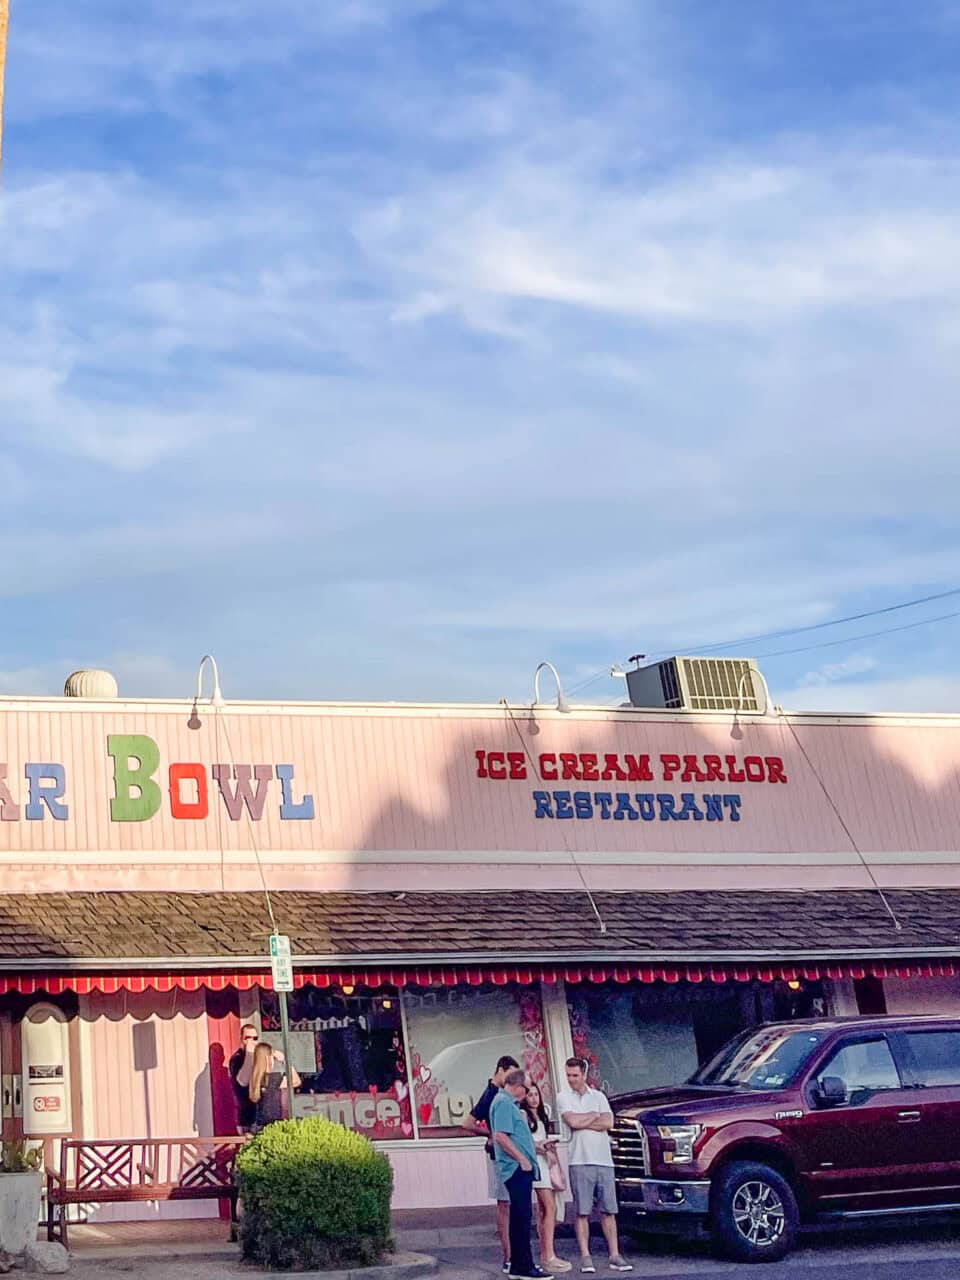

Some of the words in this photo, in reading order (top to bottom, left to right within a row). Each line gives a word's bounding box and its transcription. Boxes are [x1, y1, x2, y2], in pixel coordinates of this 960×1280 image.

[107, 734, 315, 822] BOWL
[476, 750, 527, 780] ICE
[539, 753, 654, 782] CREAM
[660, 754, 788, 784] PARLOR
[533, 791, 742, 821] RESTAURANT
